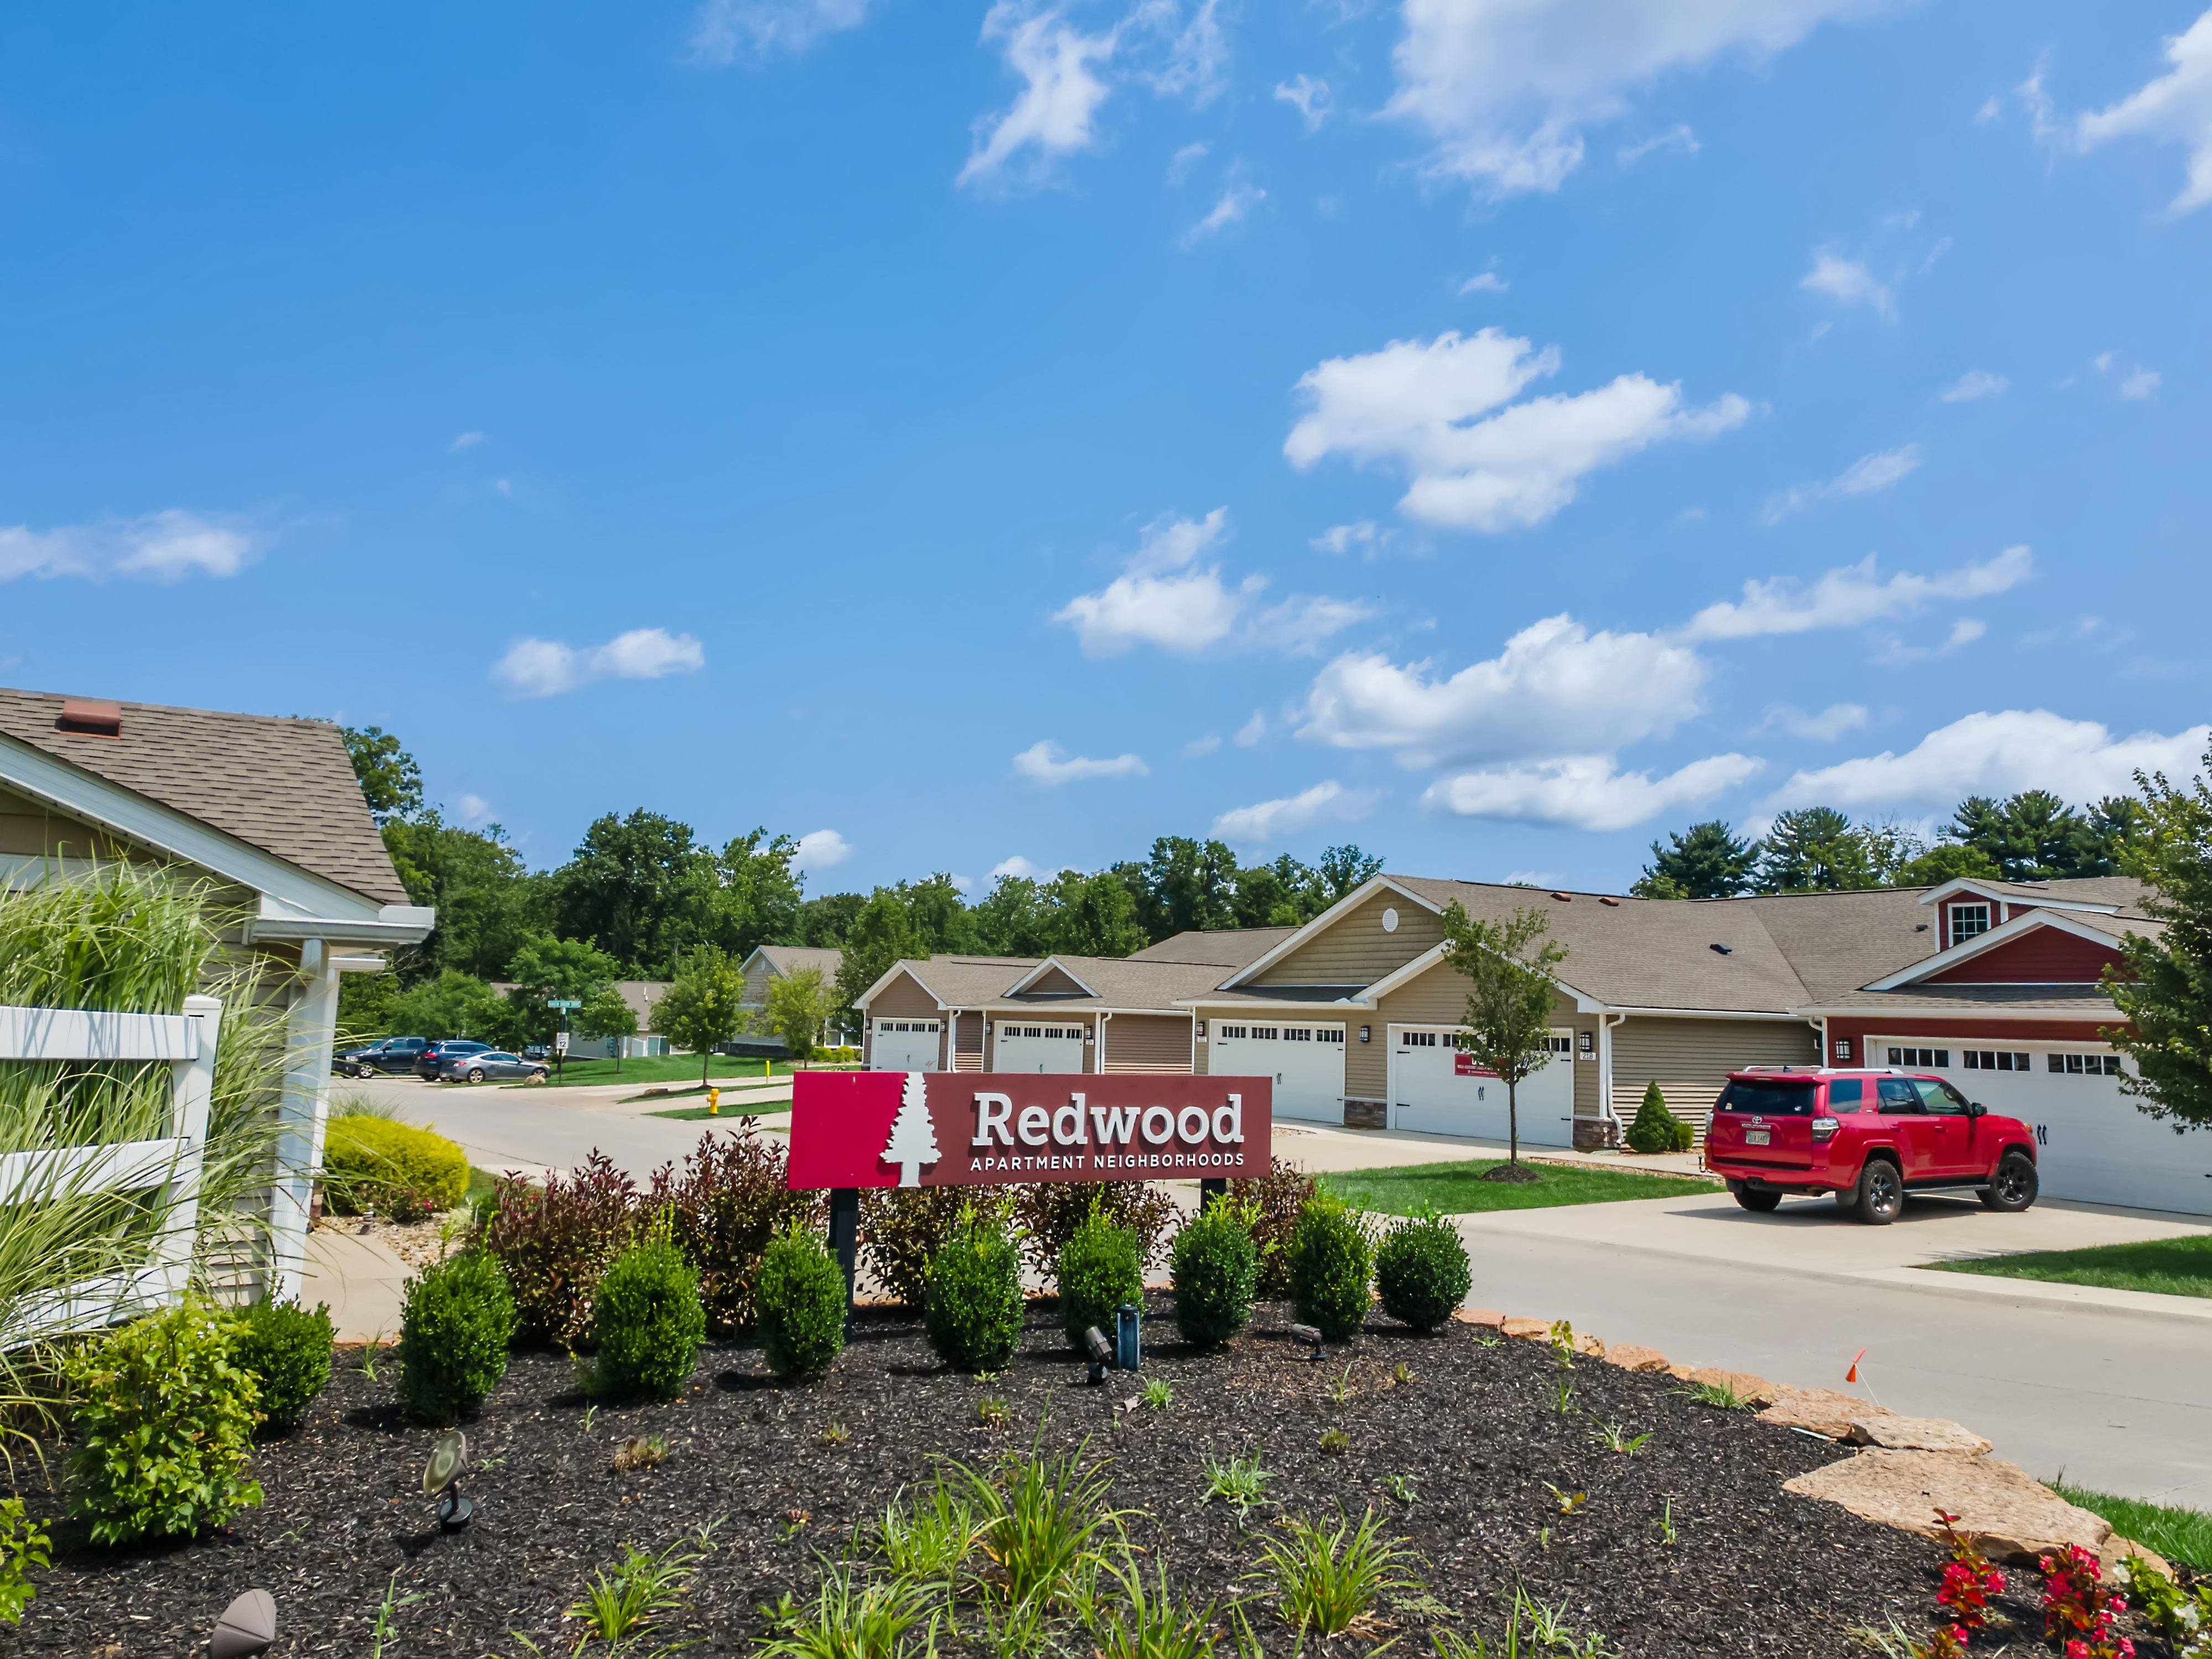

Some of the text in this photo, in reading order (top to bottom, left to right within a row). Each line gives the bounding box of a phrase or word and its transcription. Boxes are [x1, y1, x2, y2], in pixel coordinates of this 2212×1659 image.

[972, 1092, 1244, 1146] Redwood
[970, 1153, 1244, 1171] APARTMENT NEIGHBORHOODS
